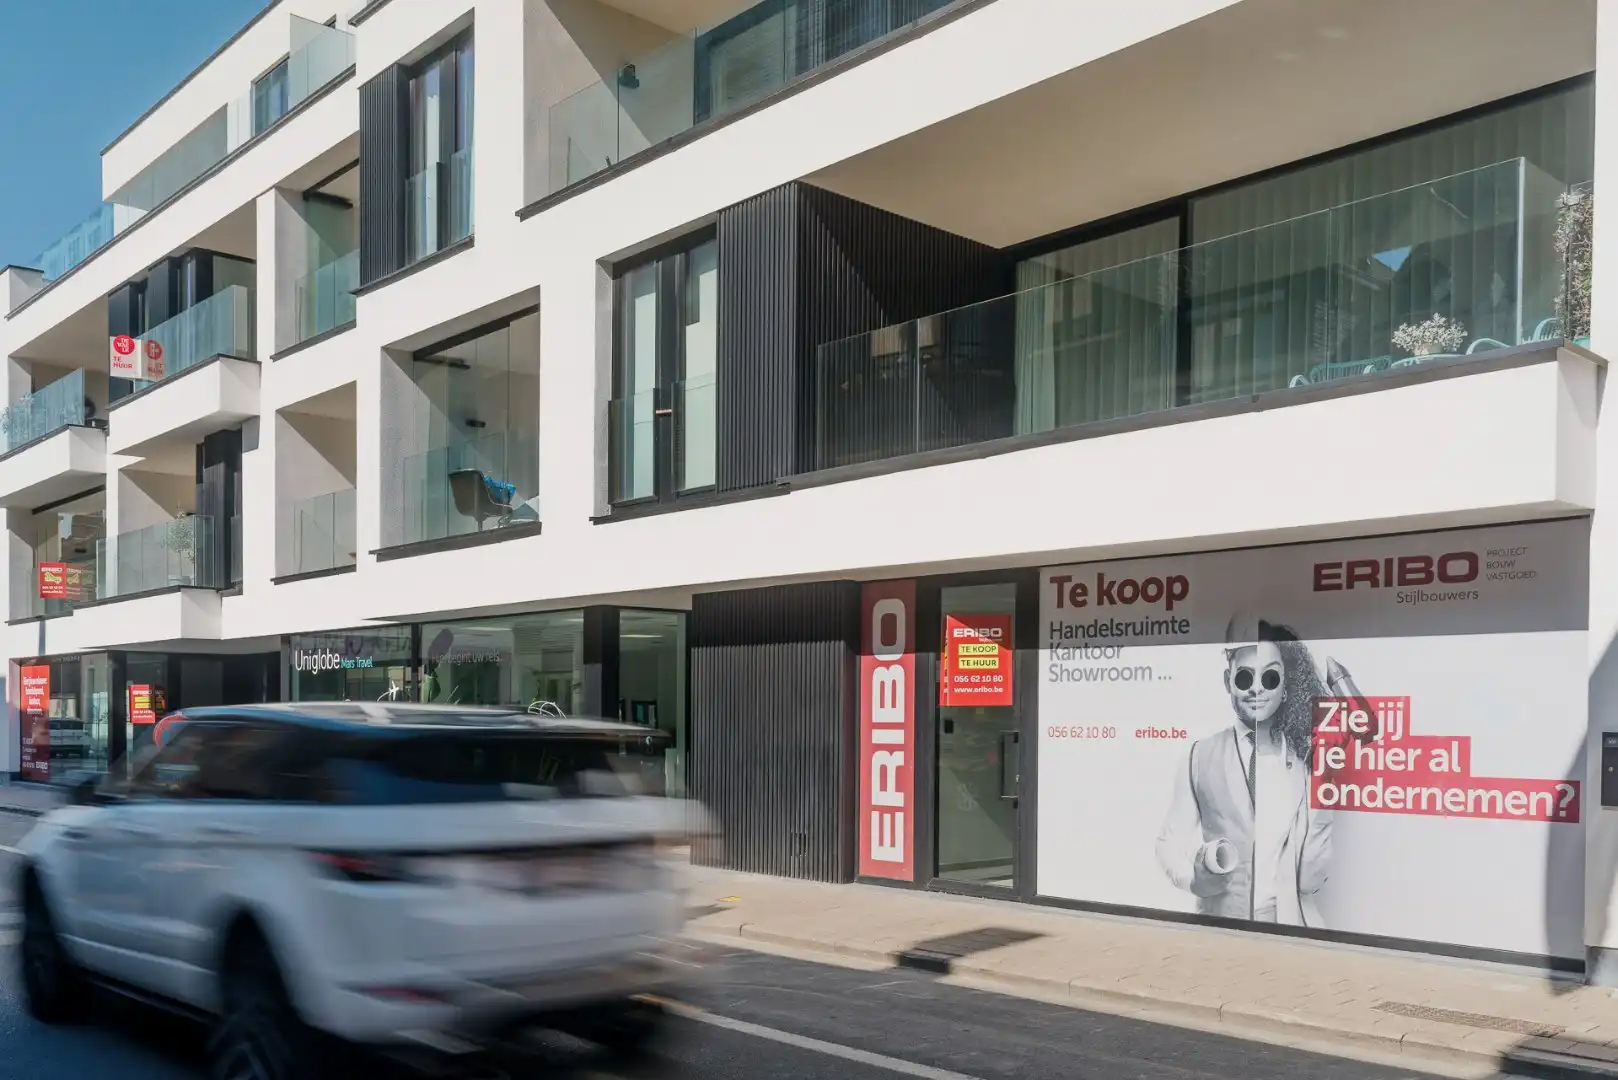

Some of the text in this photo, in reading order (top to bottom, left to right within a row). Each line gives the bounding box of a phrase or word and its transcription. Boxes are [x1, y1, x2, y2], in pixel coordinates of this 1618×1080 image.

[1486, 547, 1528, 557] PROJECT
[1313, 551, 1479, 591] ERIBO
[1486, 560, 1515, 569] BOUW
[1486, 570, 1537, 580] VASTGOED
[1050, 573, 1190, 611] Te koop
[1397, 590, 1479, 605] Stijlbouwers
[953, 628, 1002, 637] ERIBO
[1050, 616, 1190, 640] Handelsruimte
[1050, 643, 1124, 661] Kantoor
[295, 648, 373, 675] Uniglobe Mars Travel
[954, 675, 969, 683] 056
[970, 675, 980, 683] 62
[1049, 664, 1152, 682] Showroom
[1318, 702, 1404, 740] Zie jij
[871, 598, 906, 863] ERIBO
[1048, 726, 1187, 739] 056 62 10 80 eribo.be
[1314, 739, 1461, 776] je hier al
[1317, 778, 1575, 818] ondernemen?
